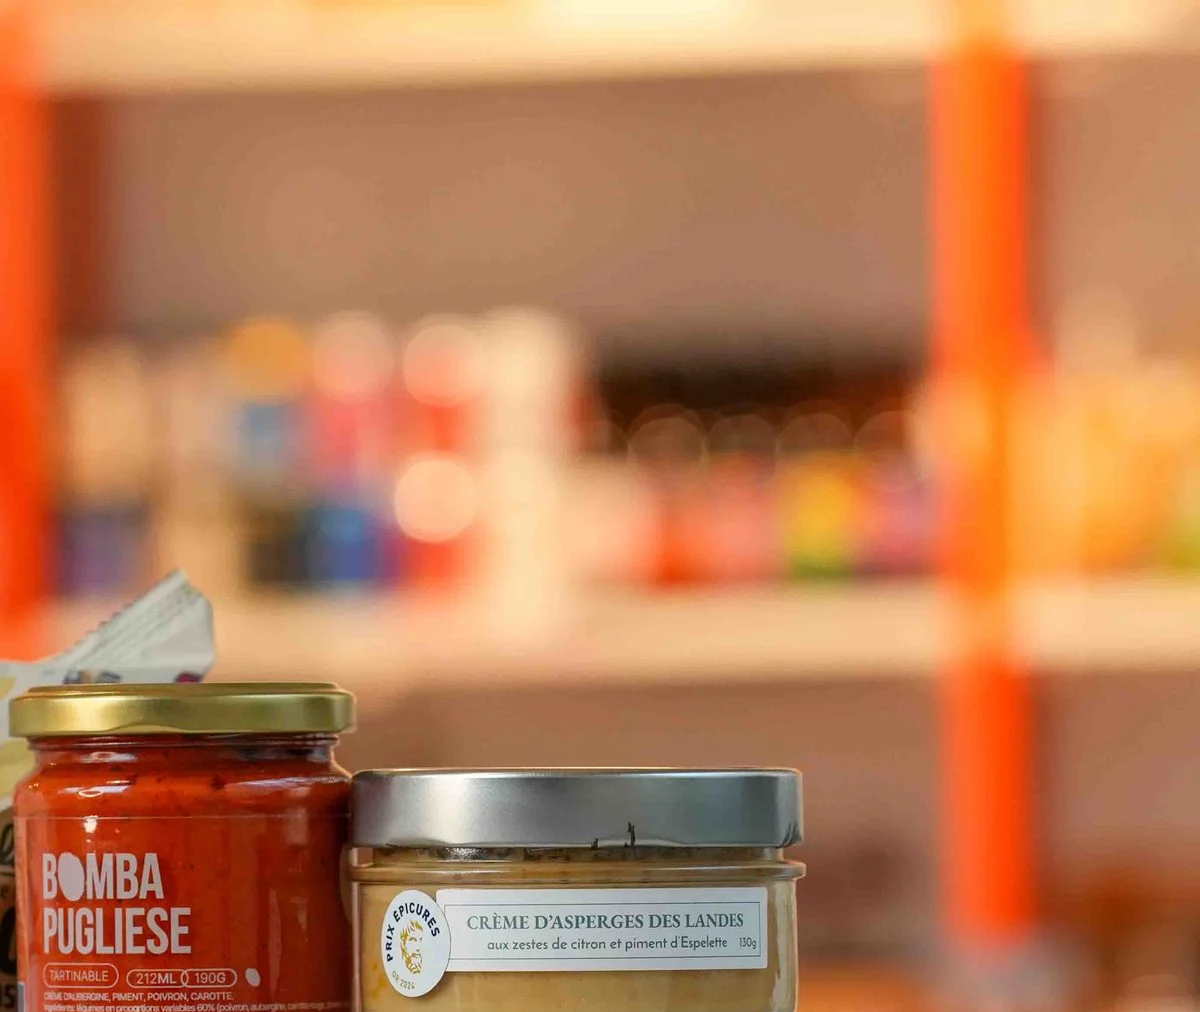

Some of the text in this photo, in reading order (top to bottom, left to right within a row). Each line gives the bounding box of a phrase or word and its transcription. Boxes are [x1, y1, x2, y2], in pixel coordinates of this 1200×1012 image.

[42, 852, 164, 901] BOMBA
[466, 912, 744, 931] CRÈME D'ASPERGES DES LANDES
[43, 907, 191, 954] PUGLIESE
[385, 924, 395, 962] PRIX
[487, 941, 509, 951] aux
[512, 939, 548, 951] zestes
[552, 937, 567, 950] de
[570, 936, 606, 950] citron
[610, 938, 622, 950] et
[625, 936, 668, 953] piment
[738, 937, 757, 951] 130g
[49, 970, 109, 982] TARTINABLE
[136, 973, 177, 985] 212ML
[194, 972, 226, 984] 190G
[113, 992, 146, 1002] PIMENT,
[147, 992, 189, 1002] POIVRON,
[191, 992, 235, 1001] CAROTTE.
